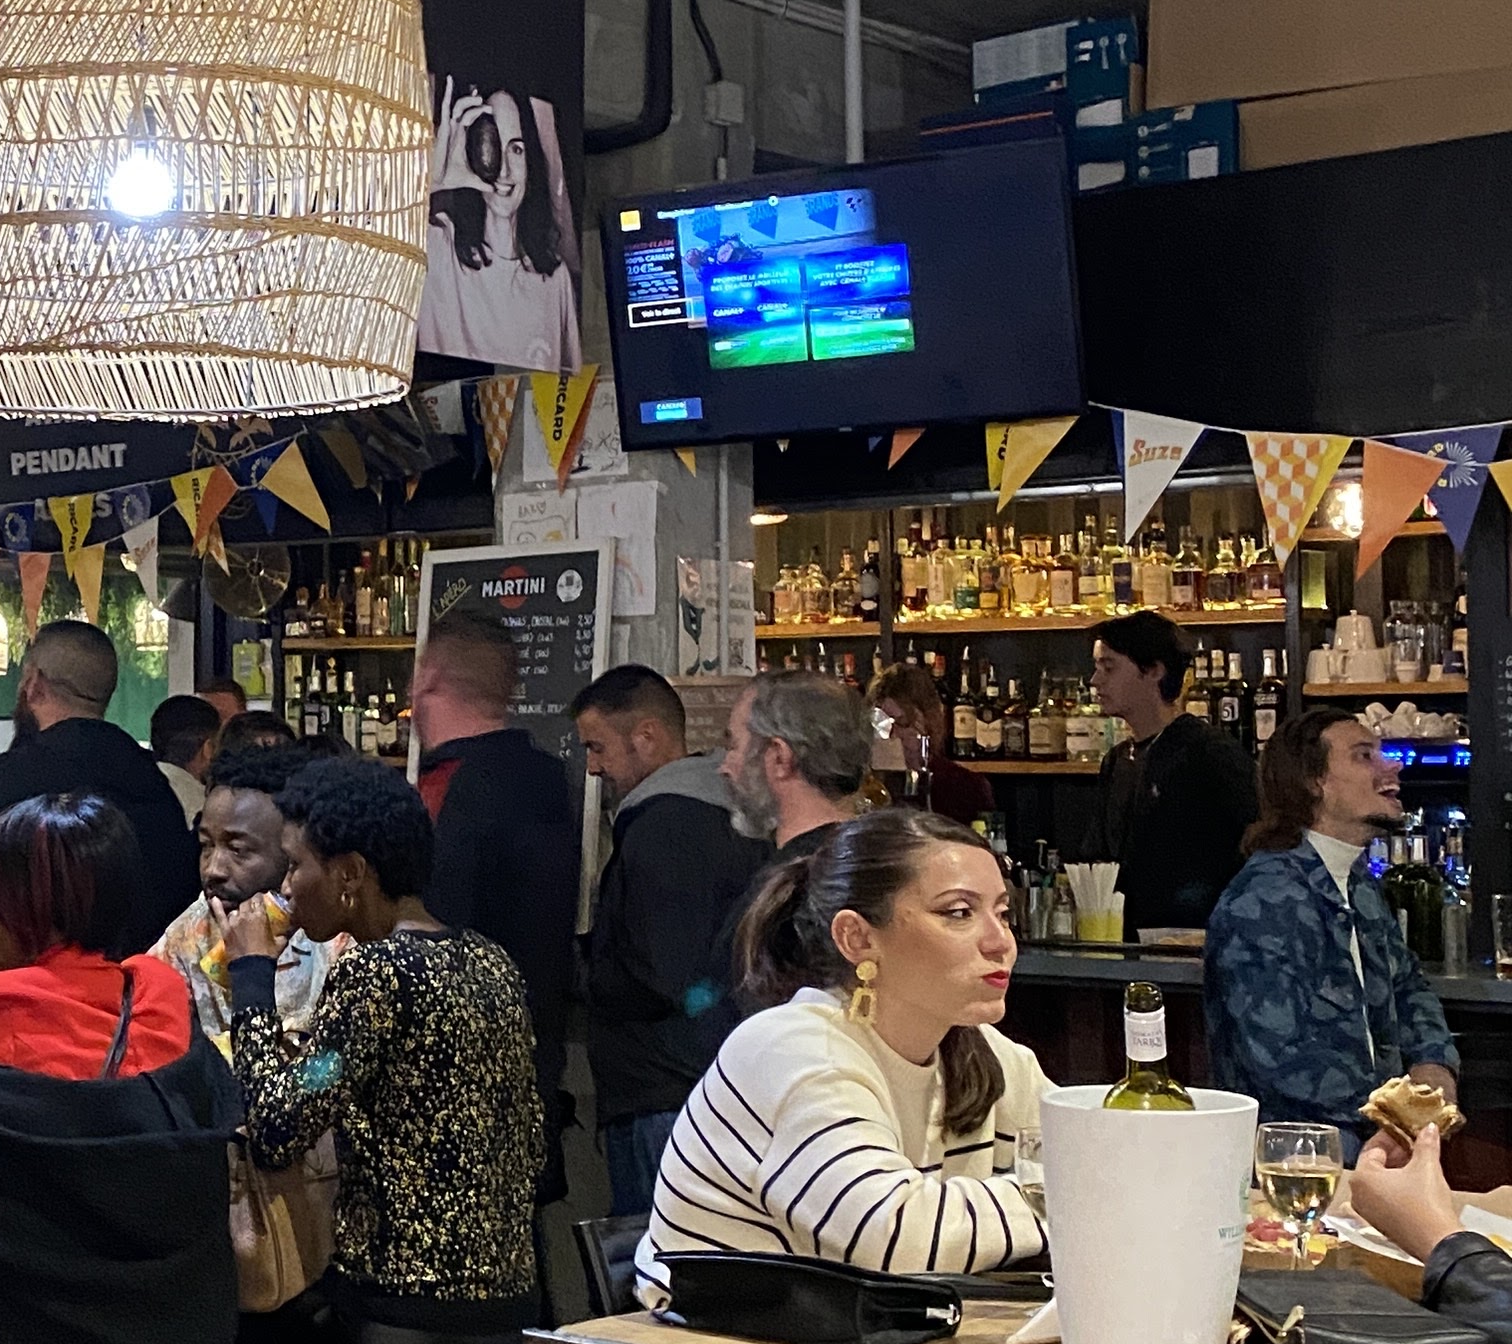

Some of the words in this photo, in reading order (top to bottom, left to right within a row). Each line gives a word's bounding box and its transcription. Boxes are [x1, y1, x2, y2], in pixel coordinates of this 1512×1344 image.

[552, 375, 569, 441] RICARD
[11, 443, 128, 476] PENDANT
[1128, 438, 1183, 468] Suze
[482, 576, 546, 598] MARTINI
